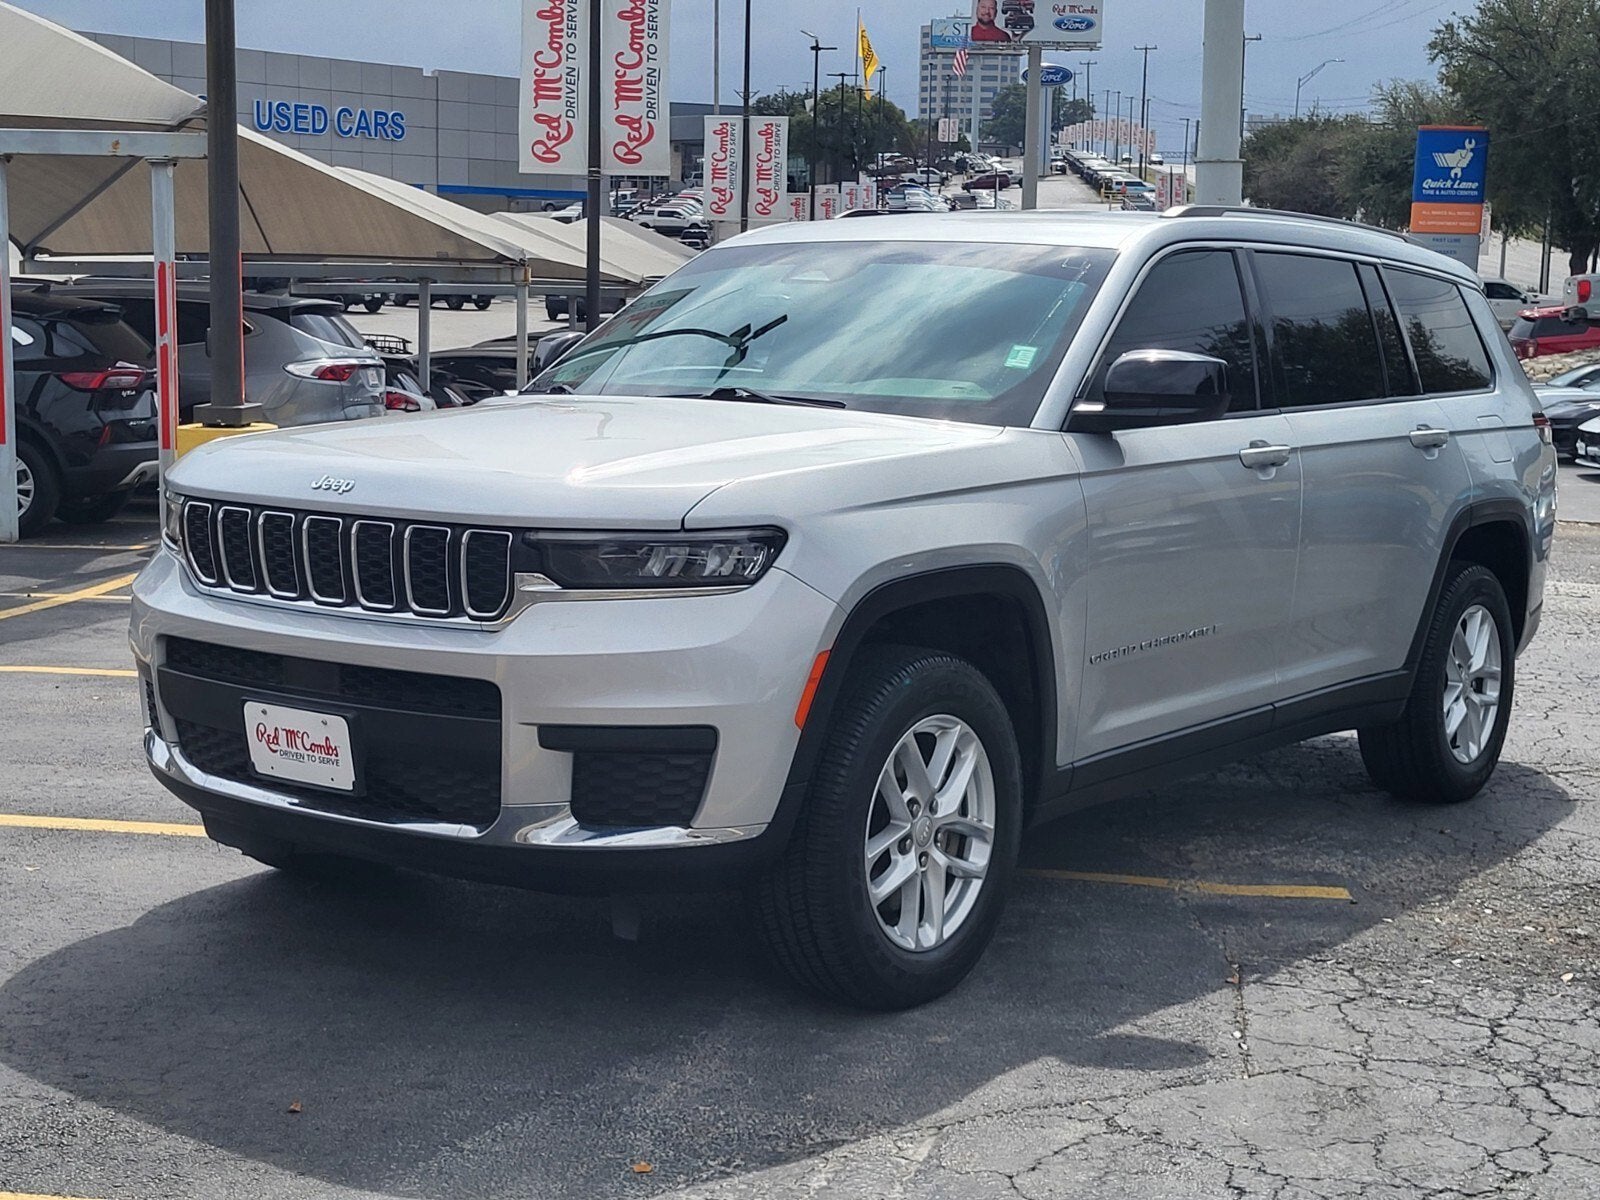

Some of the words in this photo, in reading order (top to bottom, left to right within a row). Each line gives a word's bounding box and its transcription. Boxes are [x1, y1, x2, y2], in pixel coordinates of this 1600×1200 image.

[1061, 18, 1087, 29] Ford
[566, 43, 577, 62] TO
[647, 43, 658, 62] TO
[565, 67, 577, 119] DRIVEN
[646, 67, 658, 120] DRIVEN
[253, 99, 329, 135] USED
[335, 106, 406, 141] CARS
[532, 113, 573, 163] Red
[613, 115, 654, 164] Red
[711, 122, 729, 184] McCombs
[729, 147, 736, 160] TO
[756, 122, 774, 185] McCombs
[774, 148, 781, 160] TO
[1422, 178, 1453, 189] Quick
[1453, 180, 1479, 189] Lane
[709, 186, 733, 214] Red
[755, 187, 778, 215] Red
[310, 474, 355, 495] Jeep
[255, 722, 281, 753] Red
[281, 727, 339, 757] McCombs
[279, 749, 305, 761] DRIVEN
[307, 754, 316, 763] TO
[318, 756, 340, 767] SERVE
